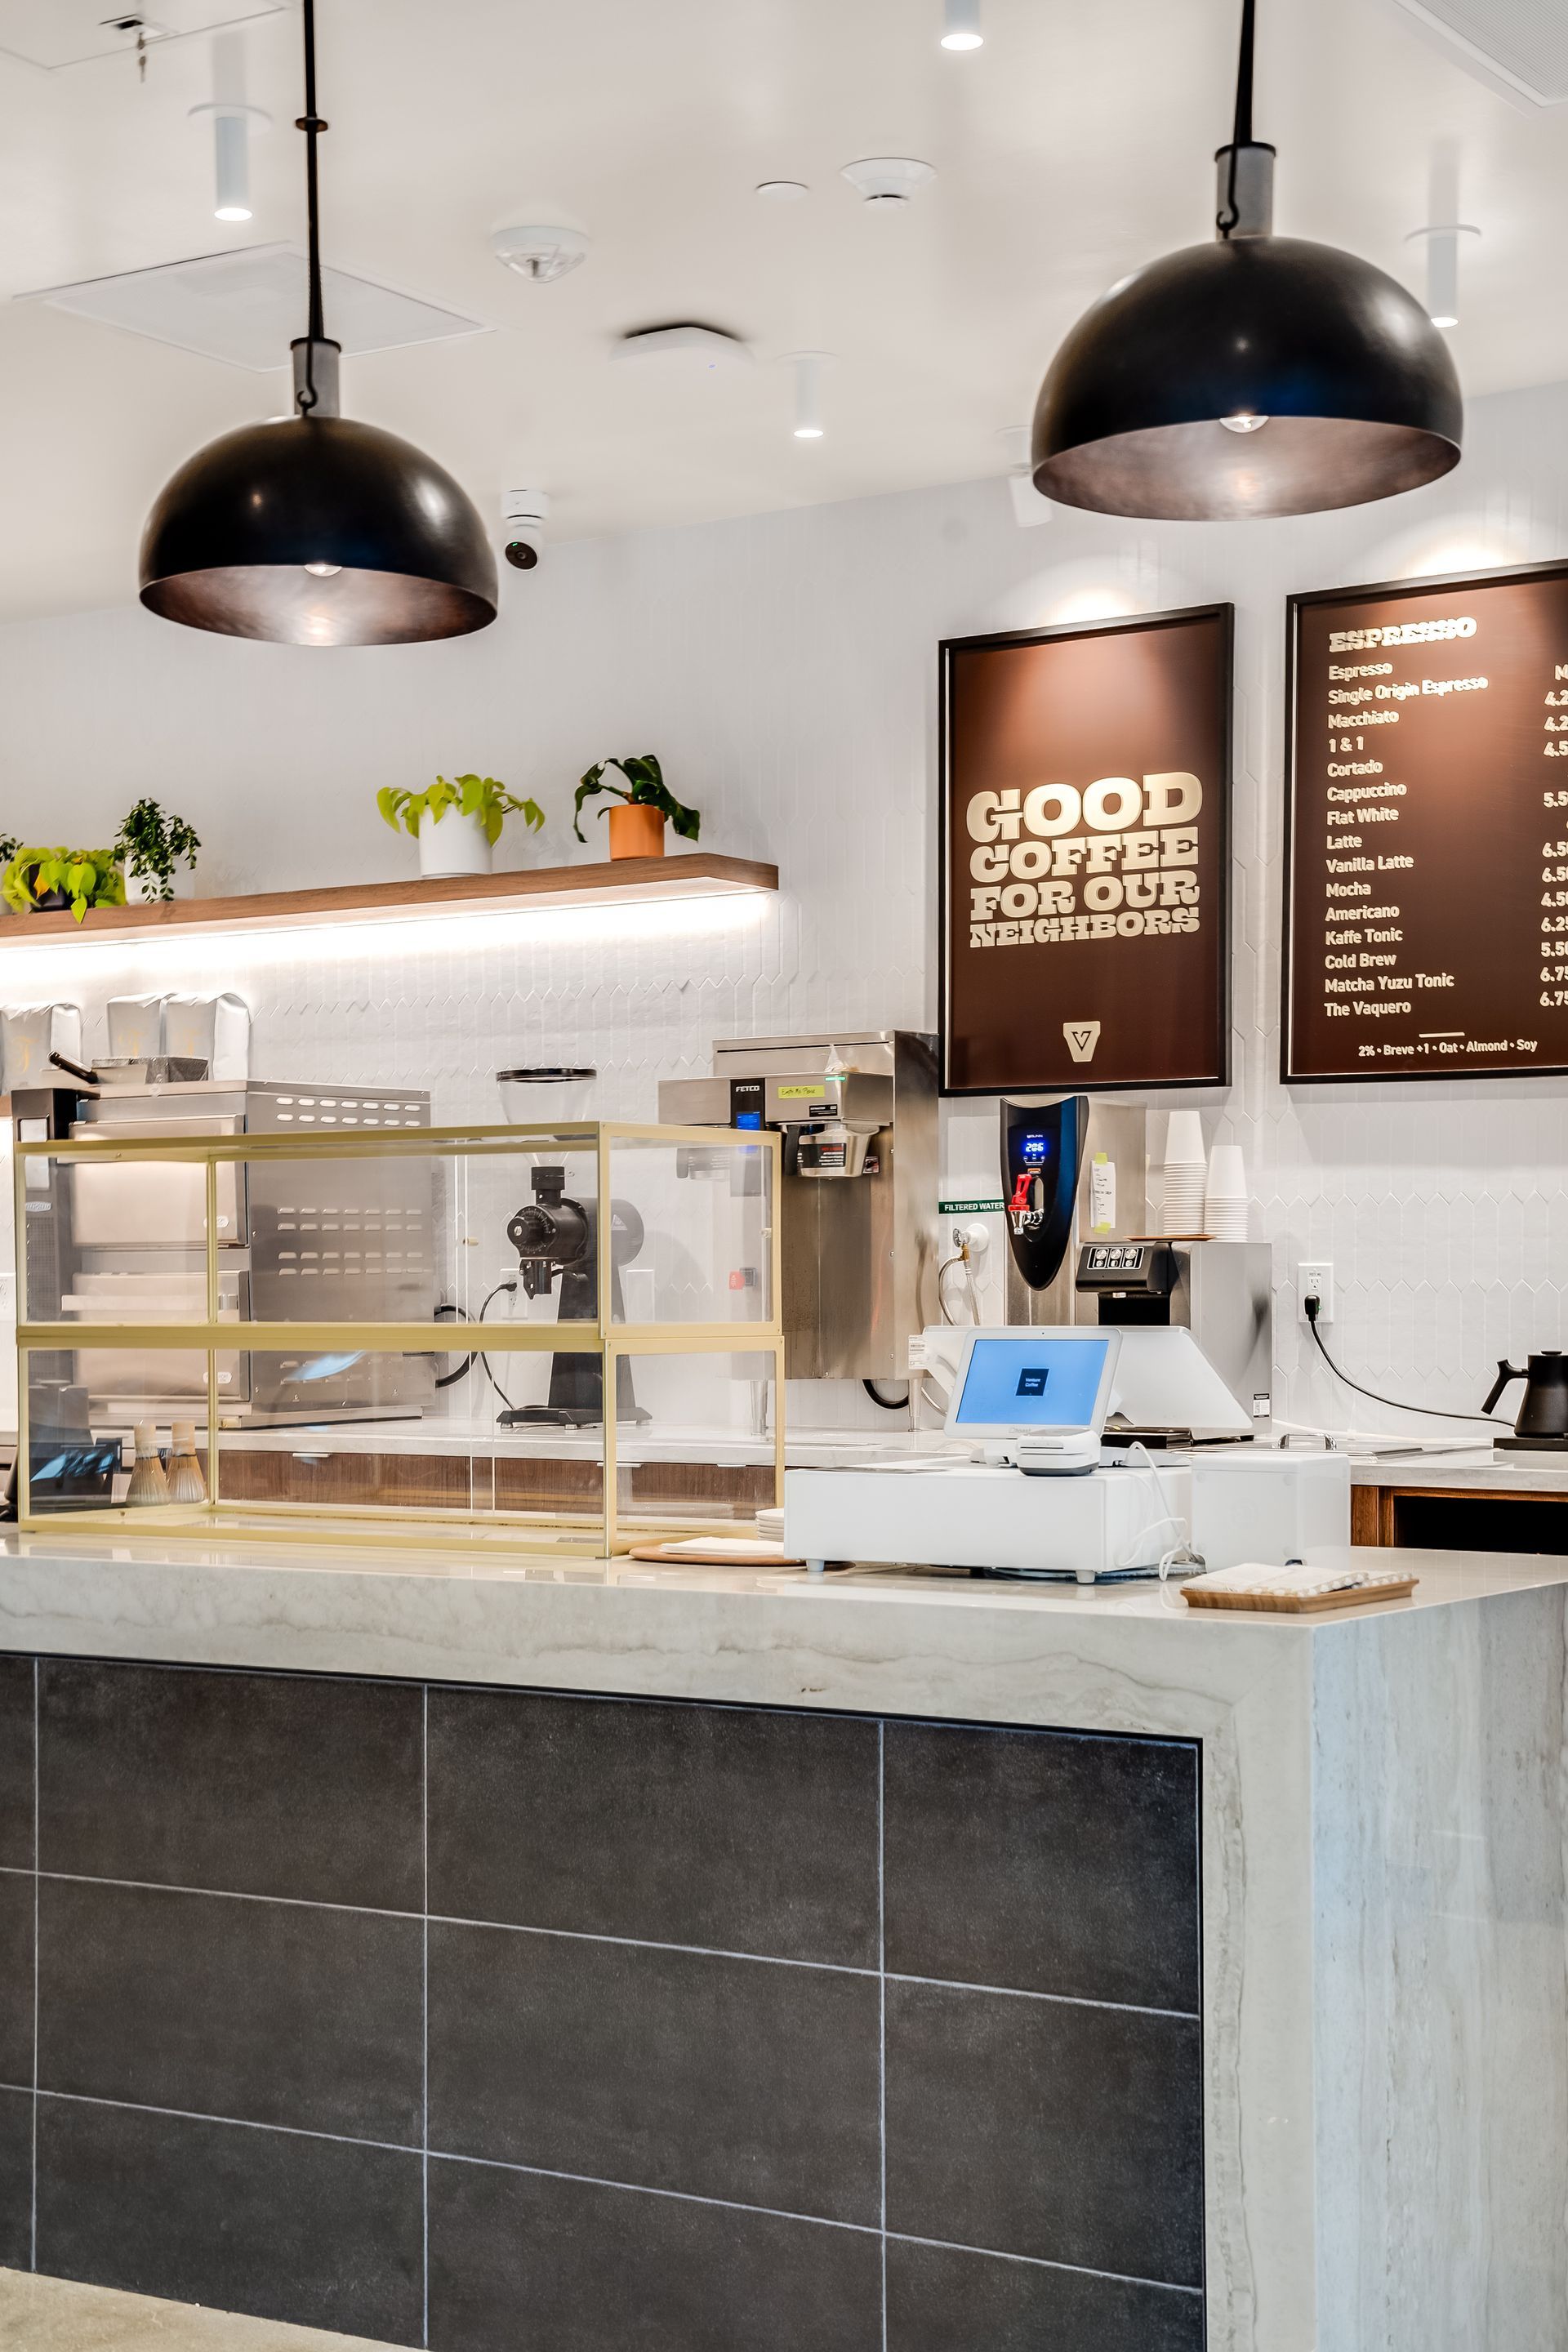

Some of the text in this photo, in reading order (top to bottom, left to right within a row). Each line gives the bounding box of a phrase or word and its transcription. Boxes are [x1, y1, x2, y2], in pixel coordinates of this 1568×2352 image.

[1329, 617, 1477, 653] ESPRESSO
[1328, 662, 1393, 681] Espresso
[1328, 677, 1489, 706] Single Origin Espresso
[1328, 710, 1400, 728] Macchiato
[1329, 736, 1364, 753] 1 & 1
[1327, 759, 1383, 777] Cortado
[1327, 782, 1407, 803] Cappuccino
[966, 771, 1203, 843] GOOD
[1326, 807, 1399, 826] Flat White
[1326, 835, 1362, 849] Latte
[1542, 841, 1568, 858] 6.5
[969, 826, 1199, 883] COFFEE
[1326, 855, 1414, 873] Vanilla Latte
[1541, 866, 1568, 883] 6.5
[970, 870, 1200, 921] FOR OUR
[1326, 881, 1371, 898] Mocha
[1540, 891, 1568, 907] 4.5
[1325, 905, 1400, 921] Americano
[969, 906, 1200, 948] NEIGHBORS
[1325, 927, 1403, 945] Kaffe Tonic
[1325, 952, 1396, 969] Cold Brew
[1325, 973, 1454, 993] Matcha Yuzu Tonic
[1324, 1000, 1412, 1018] The Vaquero
[1358, 1039, 1538, 1057] 2% Breve +1 Oat Almond Soy
[944, 1202, 1004, 1211] FILTERED WATER
